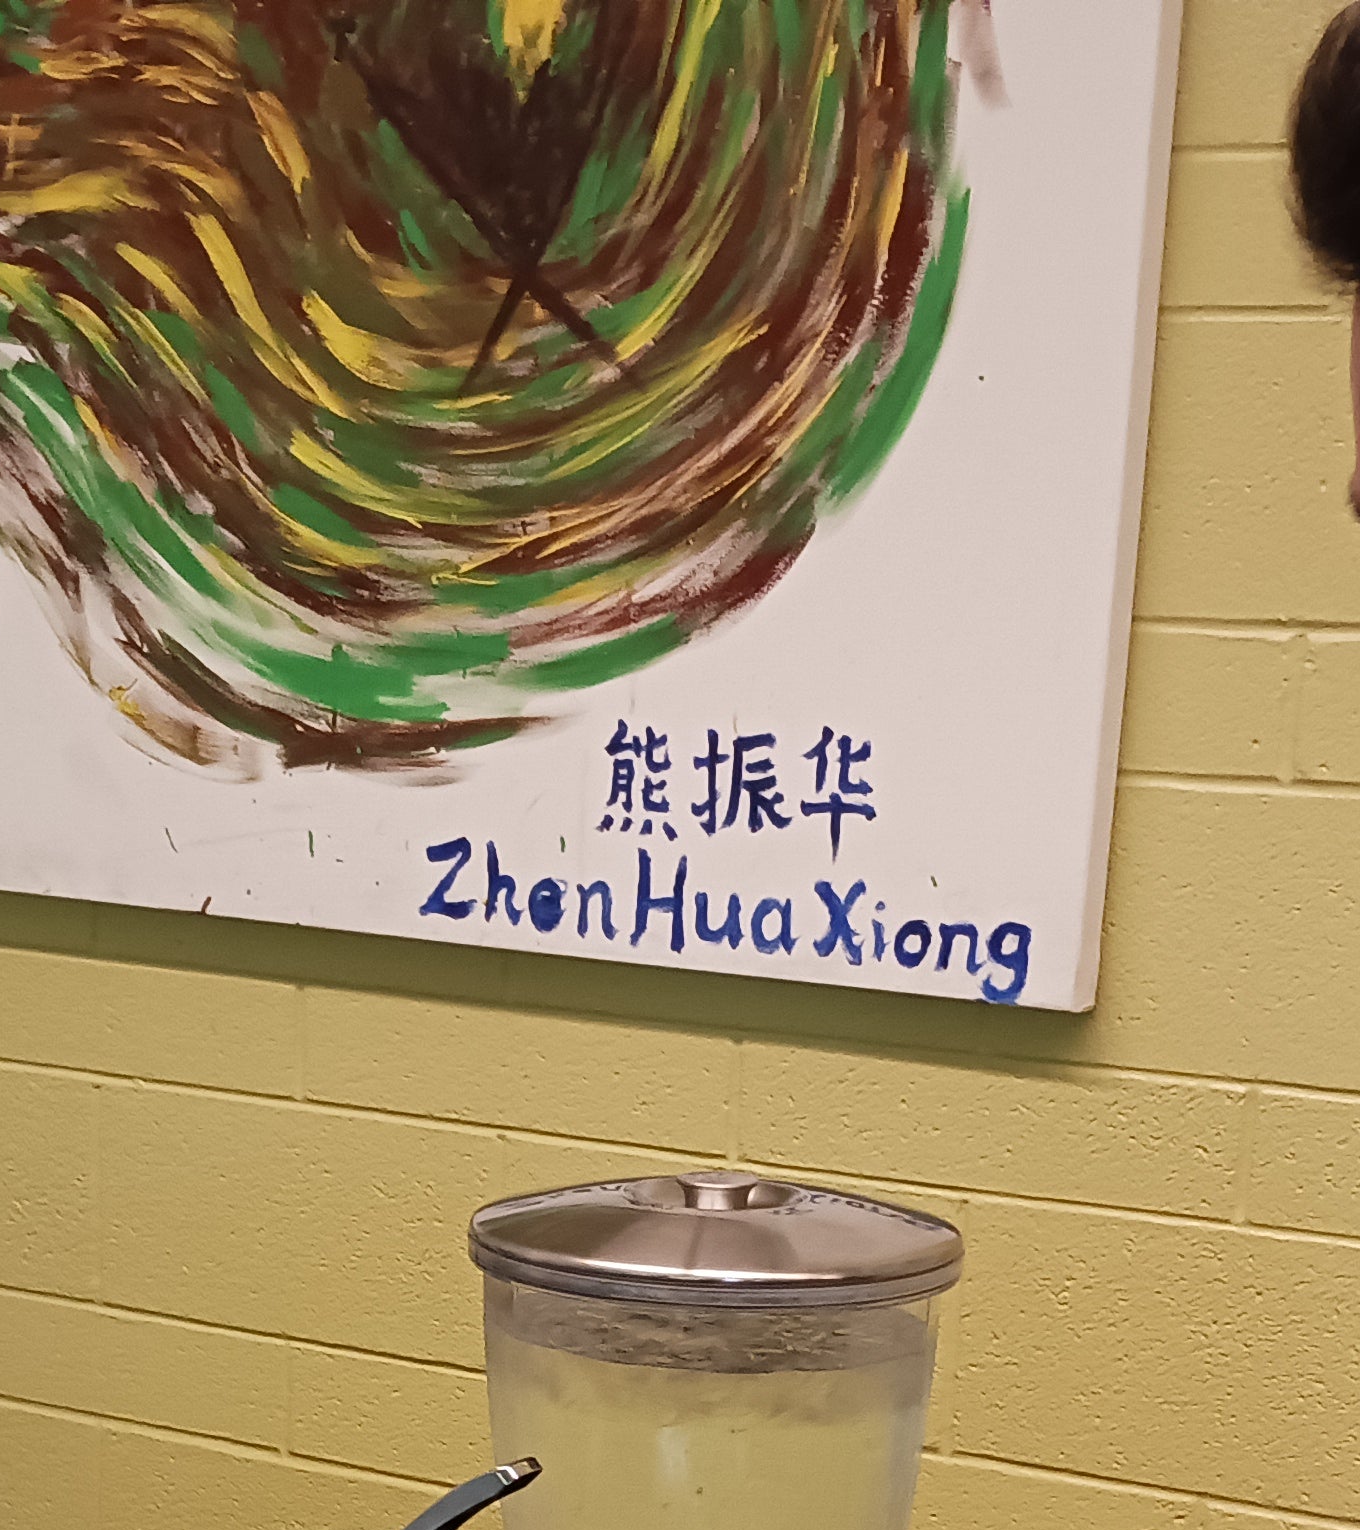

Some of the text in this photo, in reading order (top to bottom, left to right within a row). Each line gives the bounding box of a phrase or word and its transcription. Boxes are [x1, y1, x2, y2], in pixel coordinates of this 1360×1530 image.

[596, 718, 878, 864] 熊振华
[629, 847, 801, 954] Hua
[812, 878, 1033, 1006] Xiong
